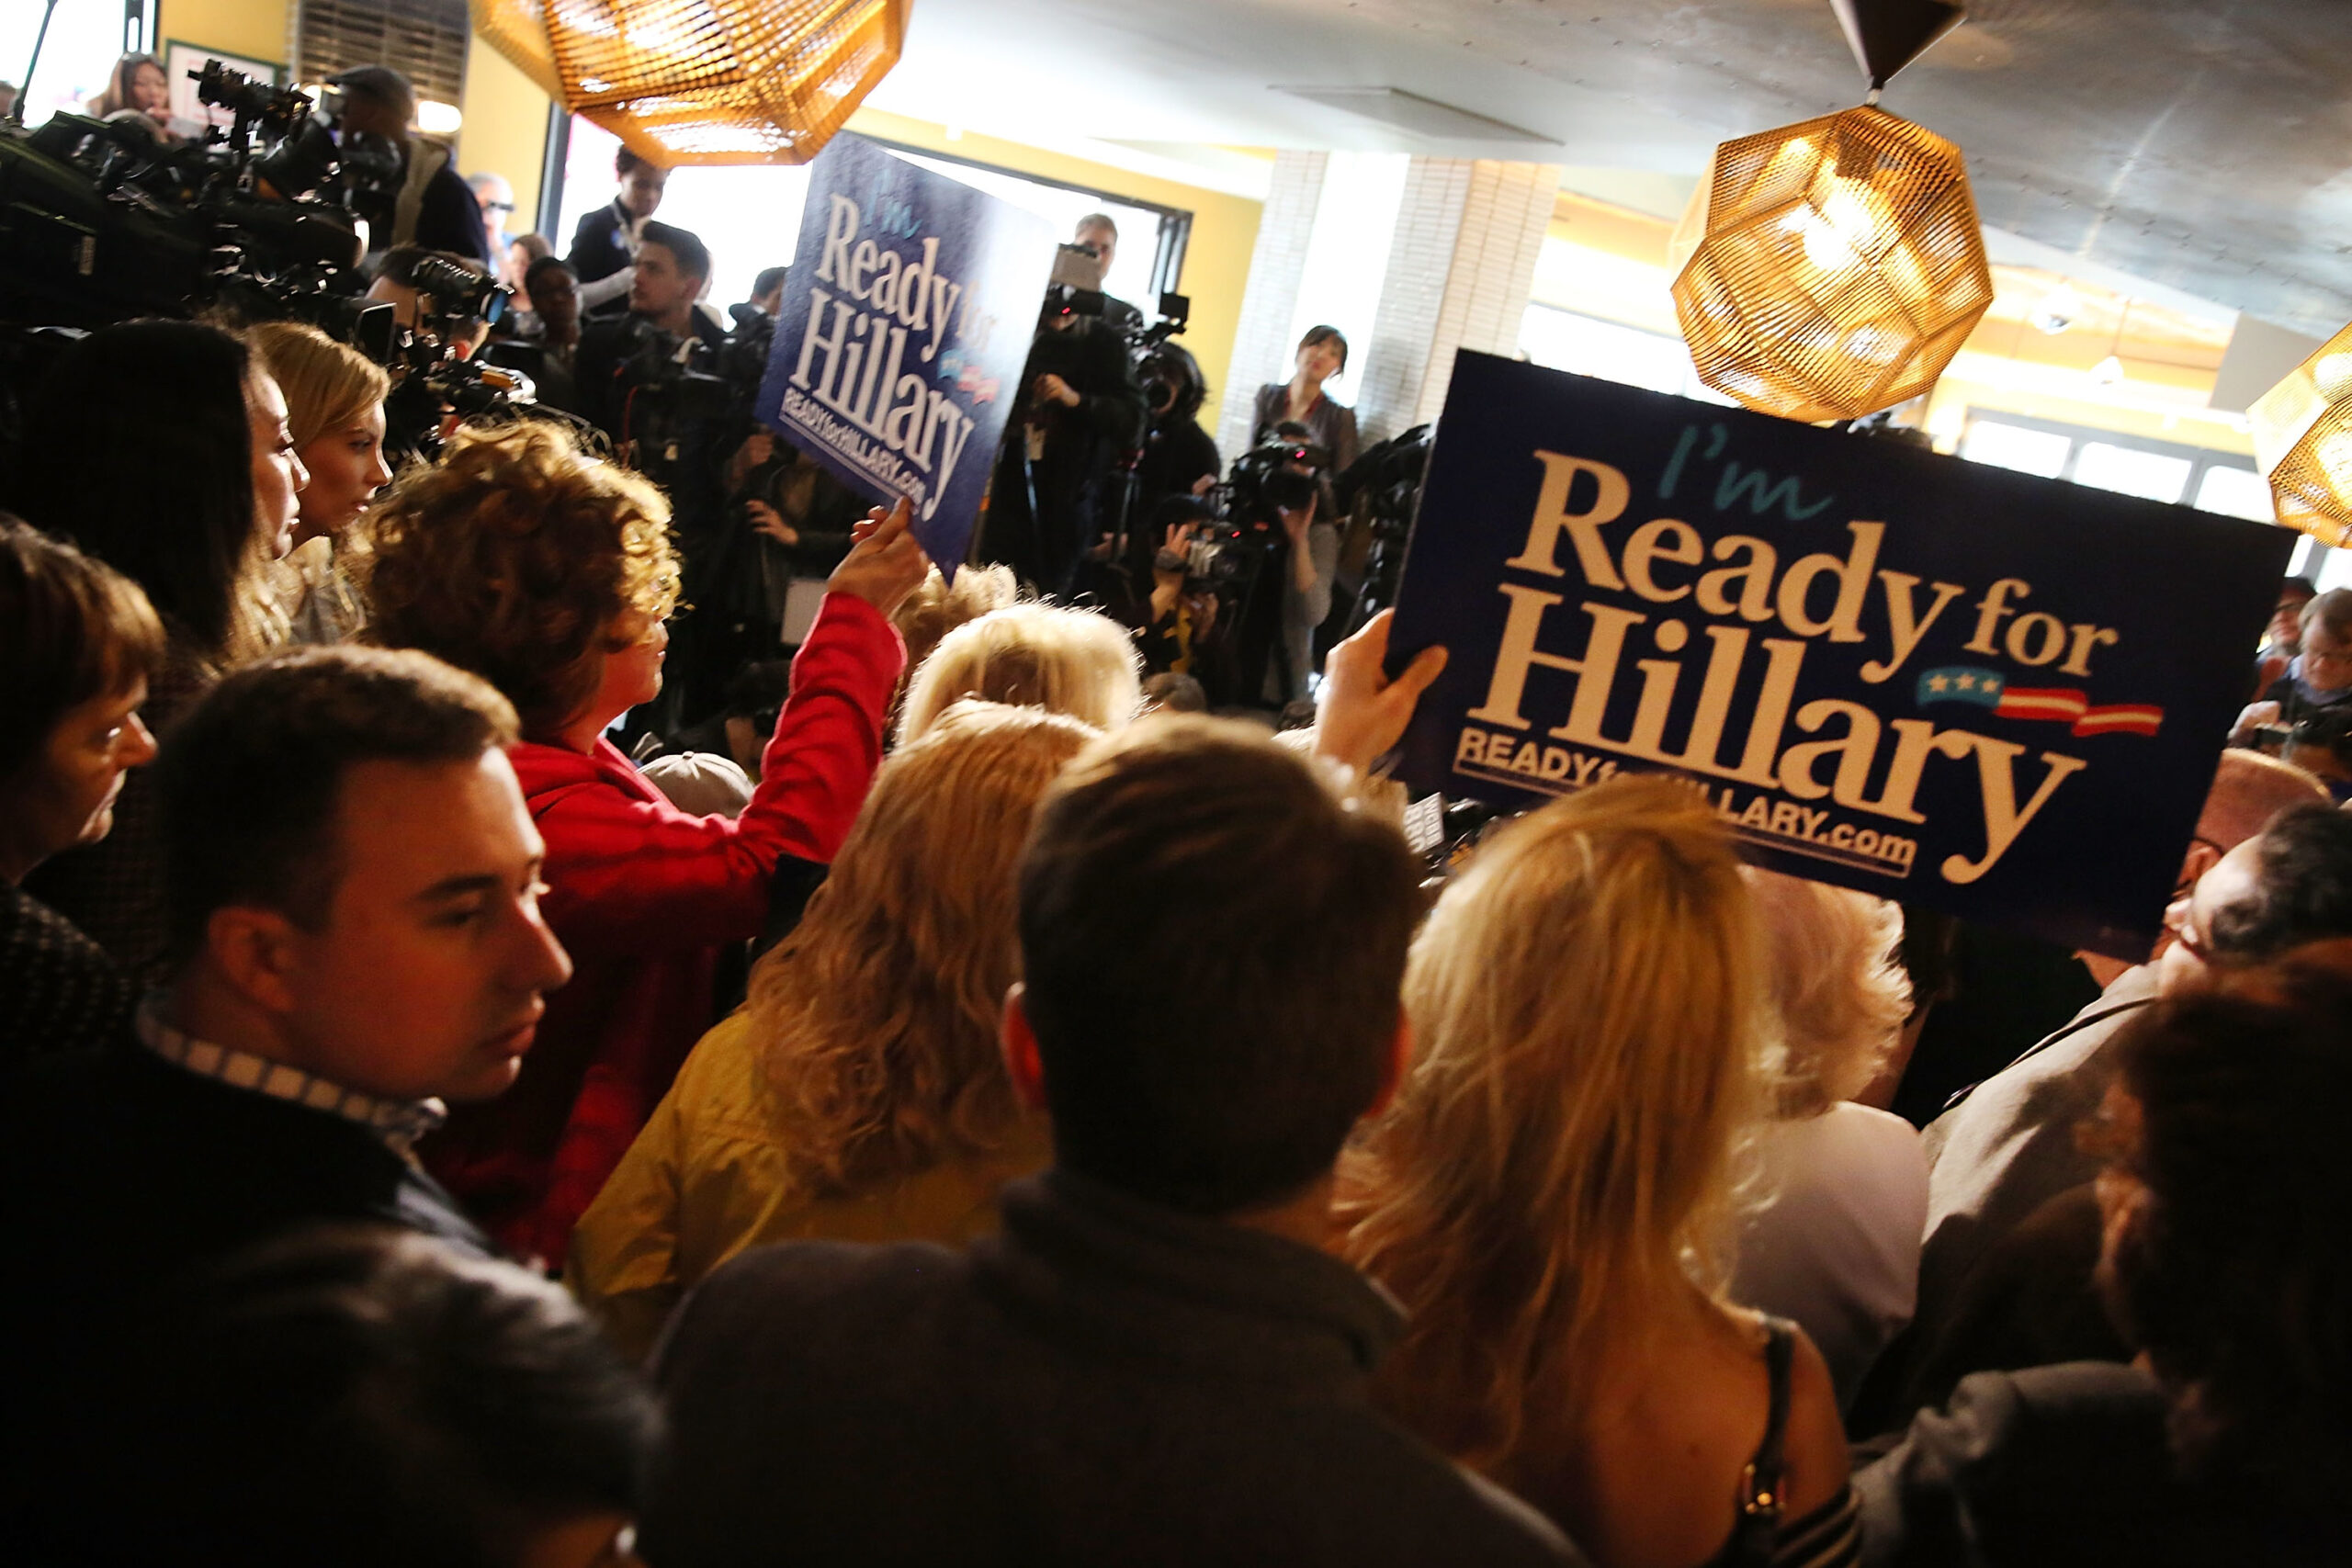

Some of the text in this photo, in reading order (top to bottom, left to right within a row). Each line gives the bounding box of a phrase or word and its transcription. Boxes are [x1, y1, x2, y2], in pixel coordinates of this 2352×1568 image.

[817, 192, 963, 363] Ready
[788, 288, 975, 522] Hillary
[1657, 423, 1834, 521] I'm
[1504, 449, 2119, 684] Ready for
[1457, 728, 1918, 863] READYfLARY.com
[1466, 582, 2087, 886] Hillary
